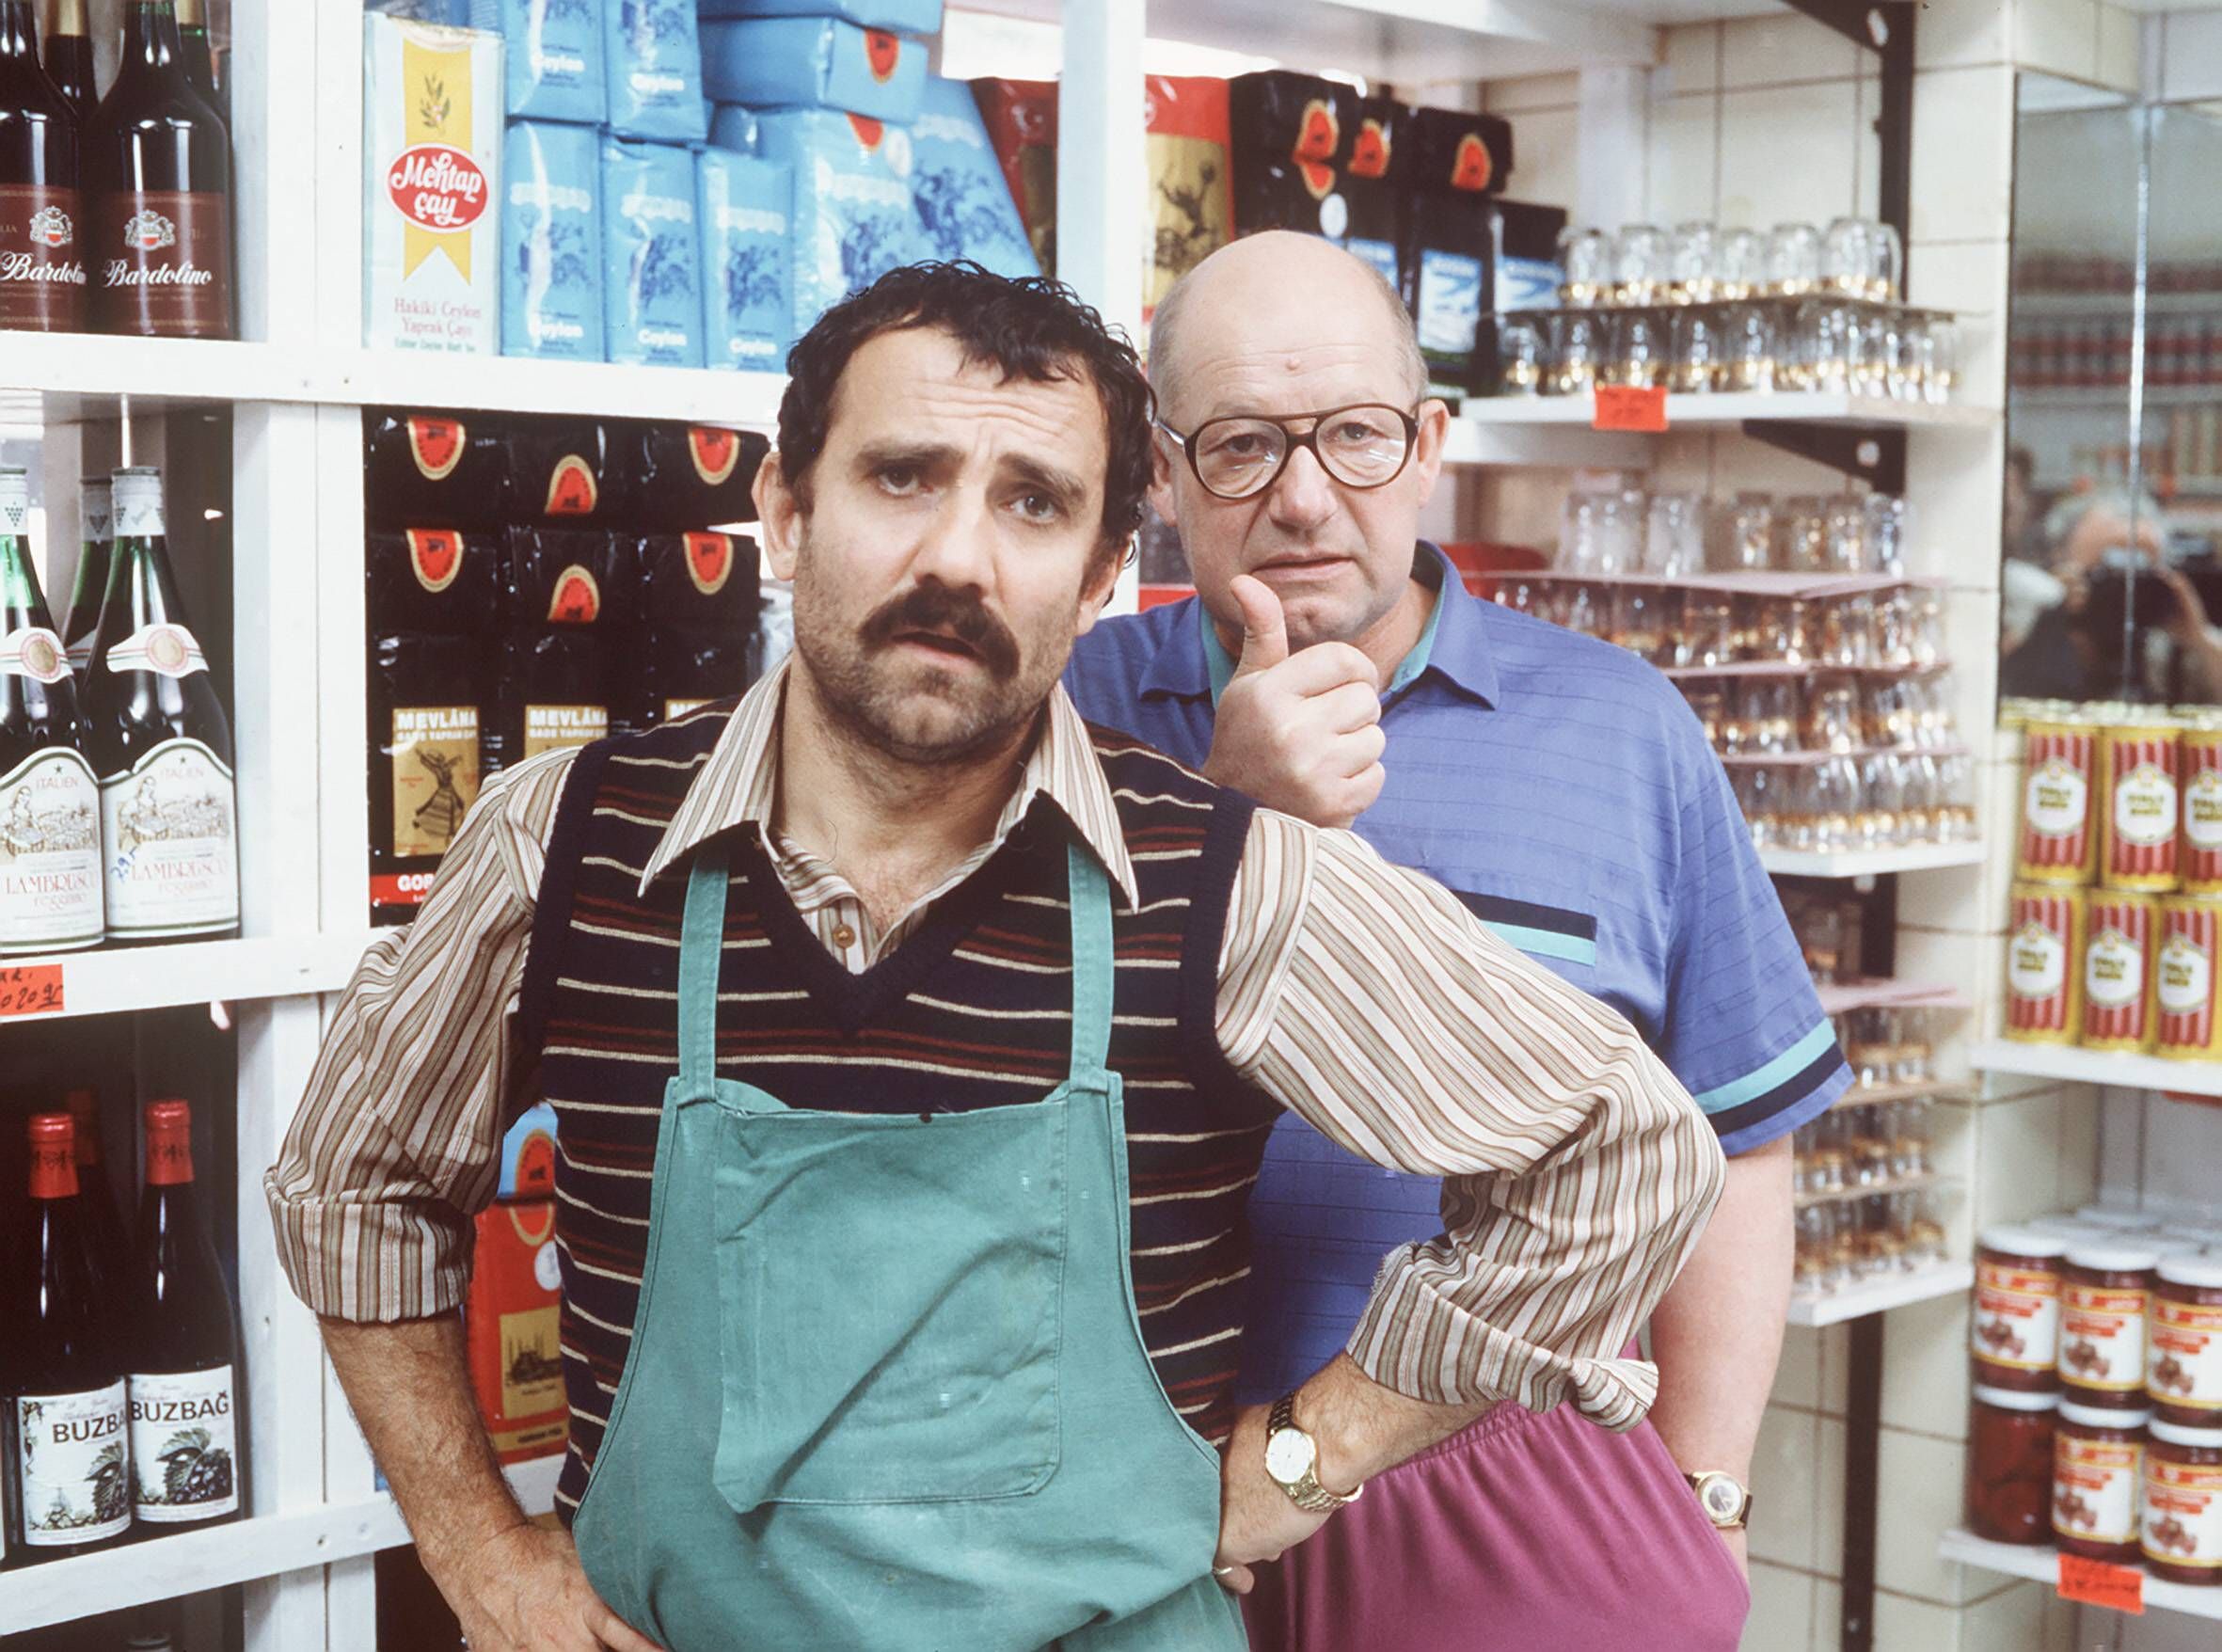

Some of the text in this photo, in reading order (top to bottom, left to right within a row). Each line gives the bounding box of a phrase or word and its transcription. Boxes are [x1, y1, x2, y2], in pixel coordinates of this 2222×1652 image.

[390, 151, 482, 203] Mehtap
[414, 191, 466, 226] çay
[103, 258, 213, 288] Bardolino
[396, 707, 477, 730] MEVLÂNA
[529, 707, 609, 726] MEVLÂNA
[36, 776, 79, 791] ITALIEN
[131, 1390, 230, 1422] BUZBAĞ
